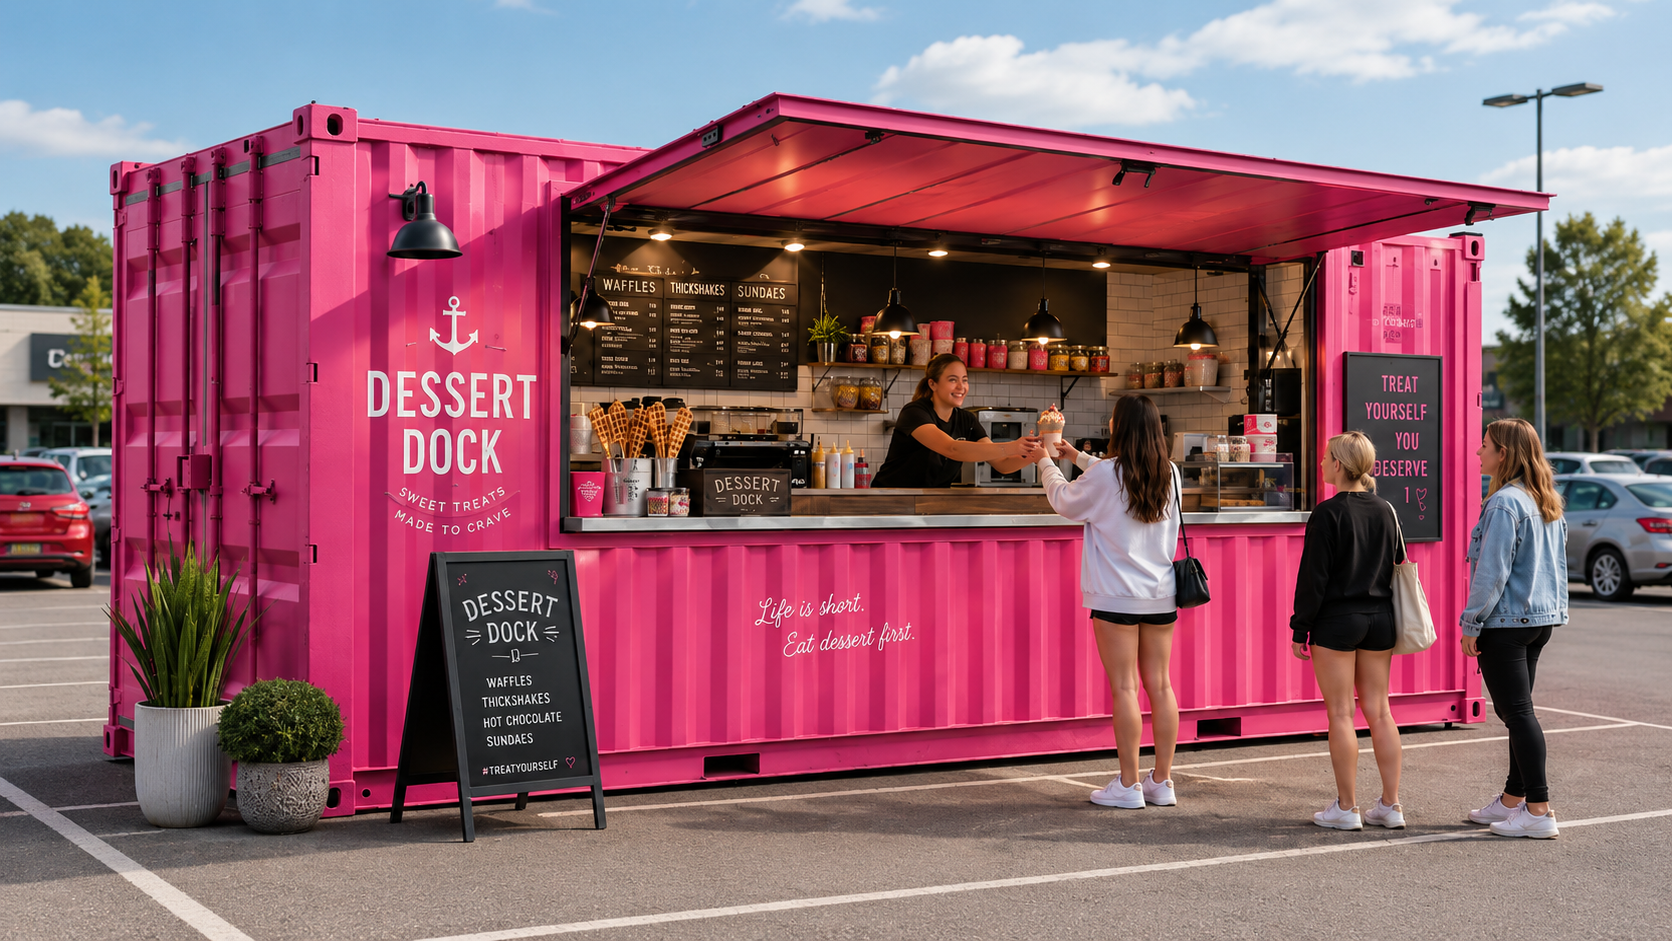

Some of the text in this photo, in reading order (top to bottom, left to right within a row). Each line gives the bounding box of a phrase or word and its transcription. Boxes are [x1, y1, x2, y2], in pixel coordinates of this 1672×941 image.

[602, 278, 656, 293] WAFFLES
[670, 281, 725, 297] THICKSHAKES
[737, 285, 786, 300] SUNDAES
[1381, 375, 1419, 393] TREAT
[367, 370, 537, 420] DESSERT
[1365, 402, 1428, 421] YOURSELF
[1395, 432, 1420, 450] YOU
[403, 428, 503, 475] DOCK
[714, 476, 781, 493] DESSERT
[399, 486, 506, 512] SWEET TREATS
[732, 494, 764, 506] DOCK
[394, 507, 511, 535] MADE TO CRAVE
[462, 590, 559, 622] DESSERT
[755, 593, 865, 628] Life is short.
[486, 621, 539, 644] DOCK
[783, 622, 915, 657] Eat dessert first.
[486, 675, 533, 688] WAFFLES
[482, 692, 551, 708] THICKSHAKES
[483, 711, 562, 728] HOT CHOCOLATE
[486, 733, 534, 747] SUNDAES
[482, 760, 559, 775] #TREATYOURSELF
